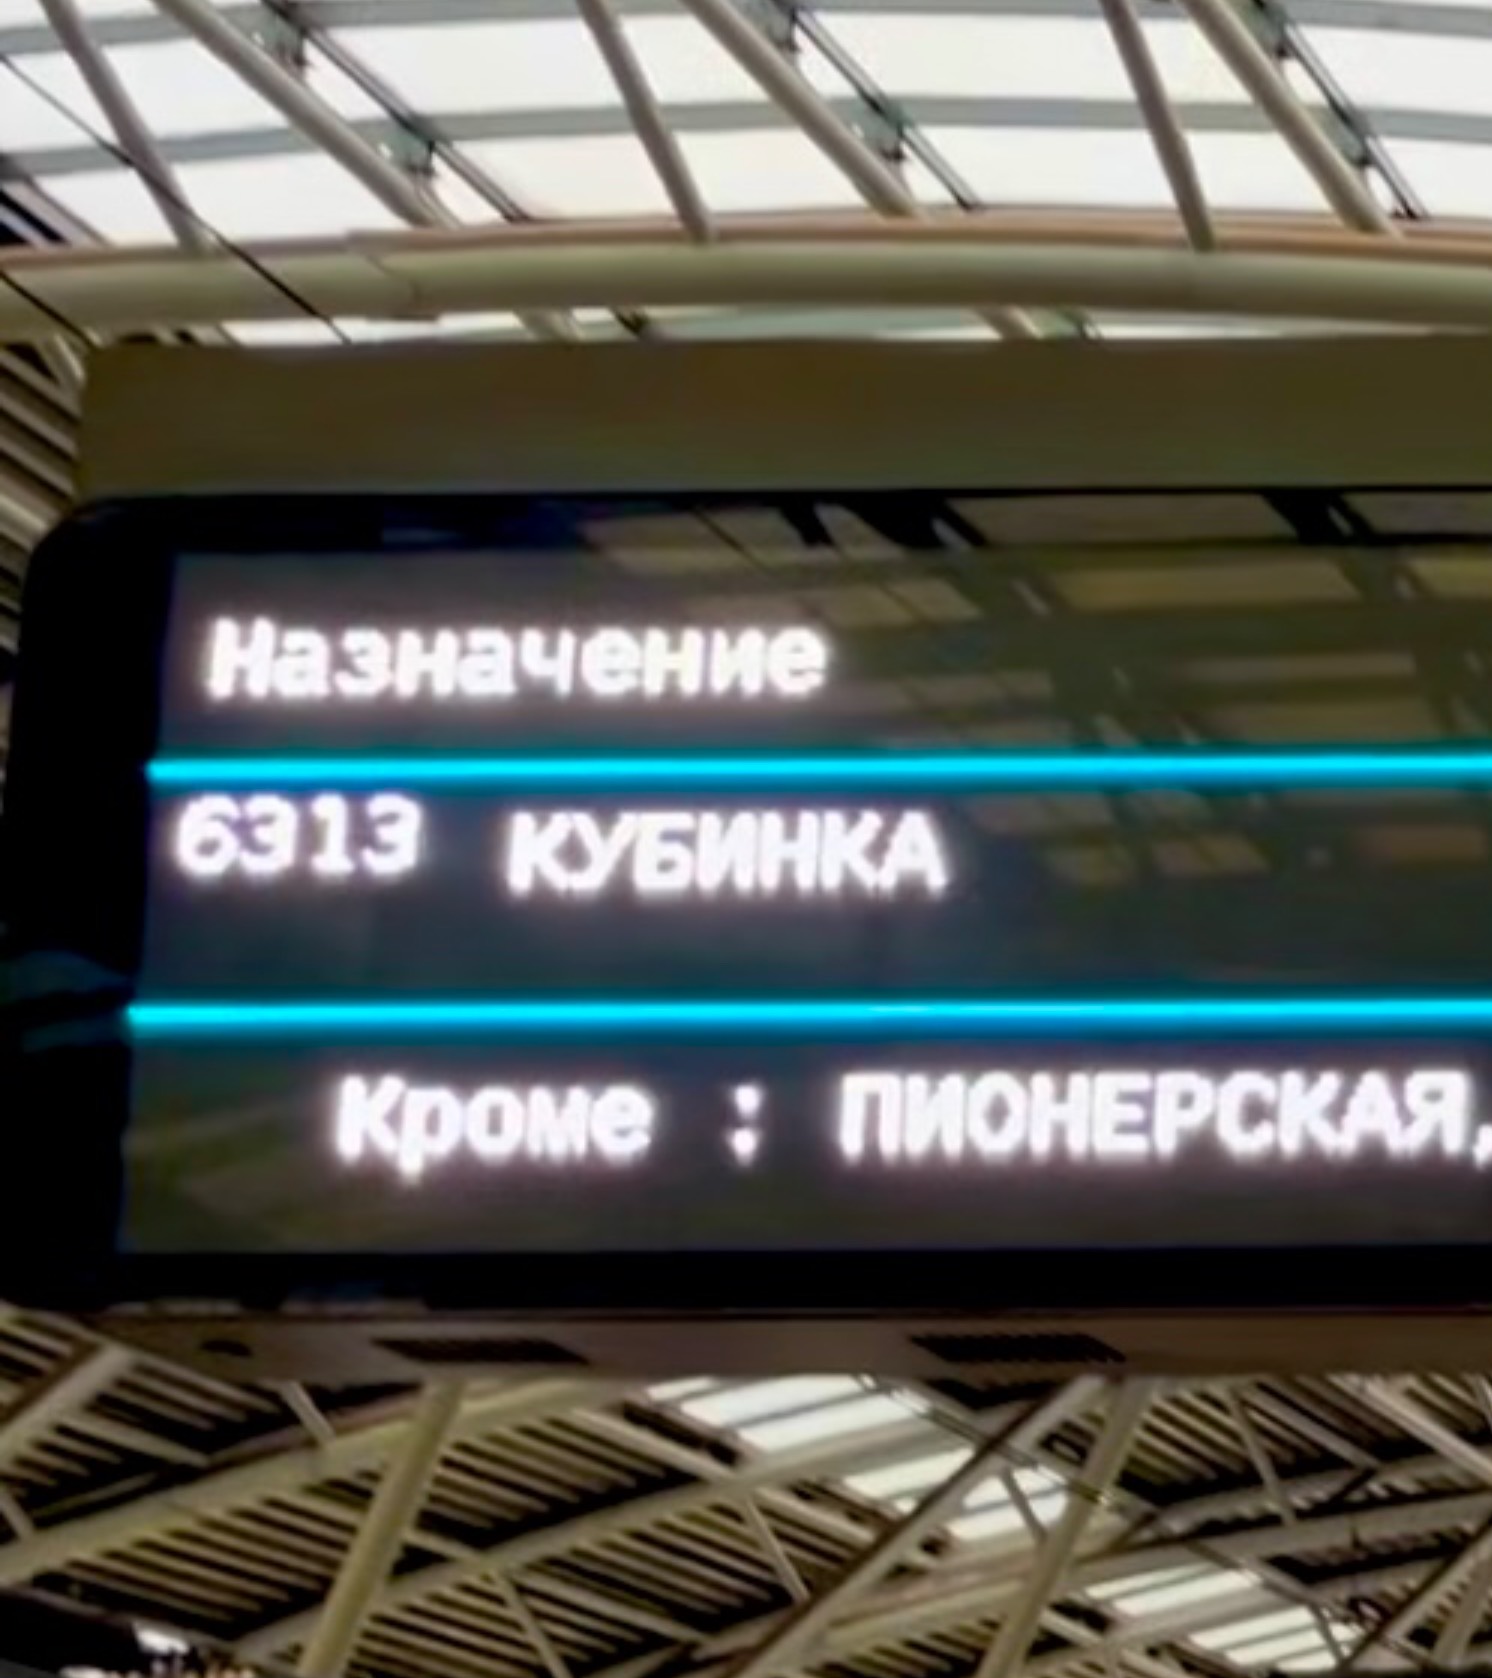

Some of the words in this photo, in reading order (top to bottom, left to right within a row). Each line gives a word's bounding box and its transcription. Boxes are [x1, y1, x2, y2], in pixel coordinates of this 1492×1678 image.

[204, 616, 830, 702] Назначение
[174, 793, 424, 879] 6313
[504, 808, 949, 897] КУБИНКА
[332, 1073, 656, 1180] Кроме
[729, 1084, 762, 1159] :
